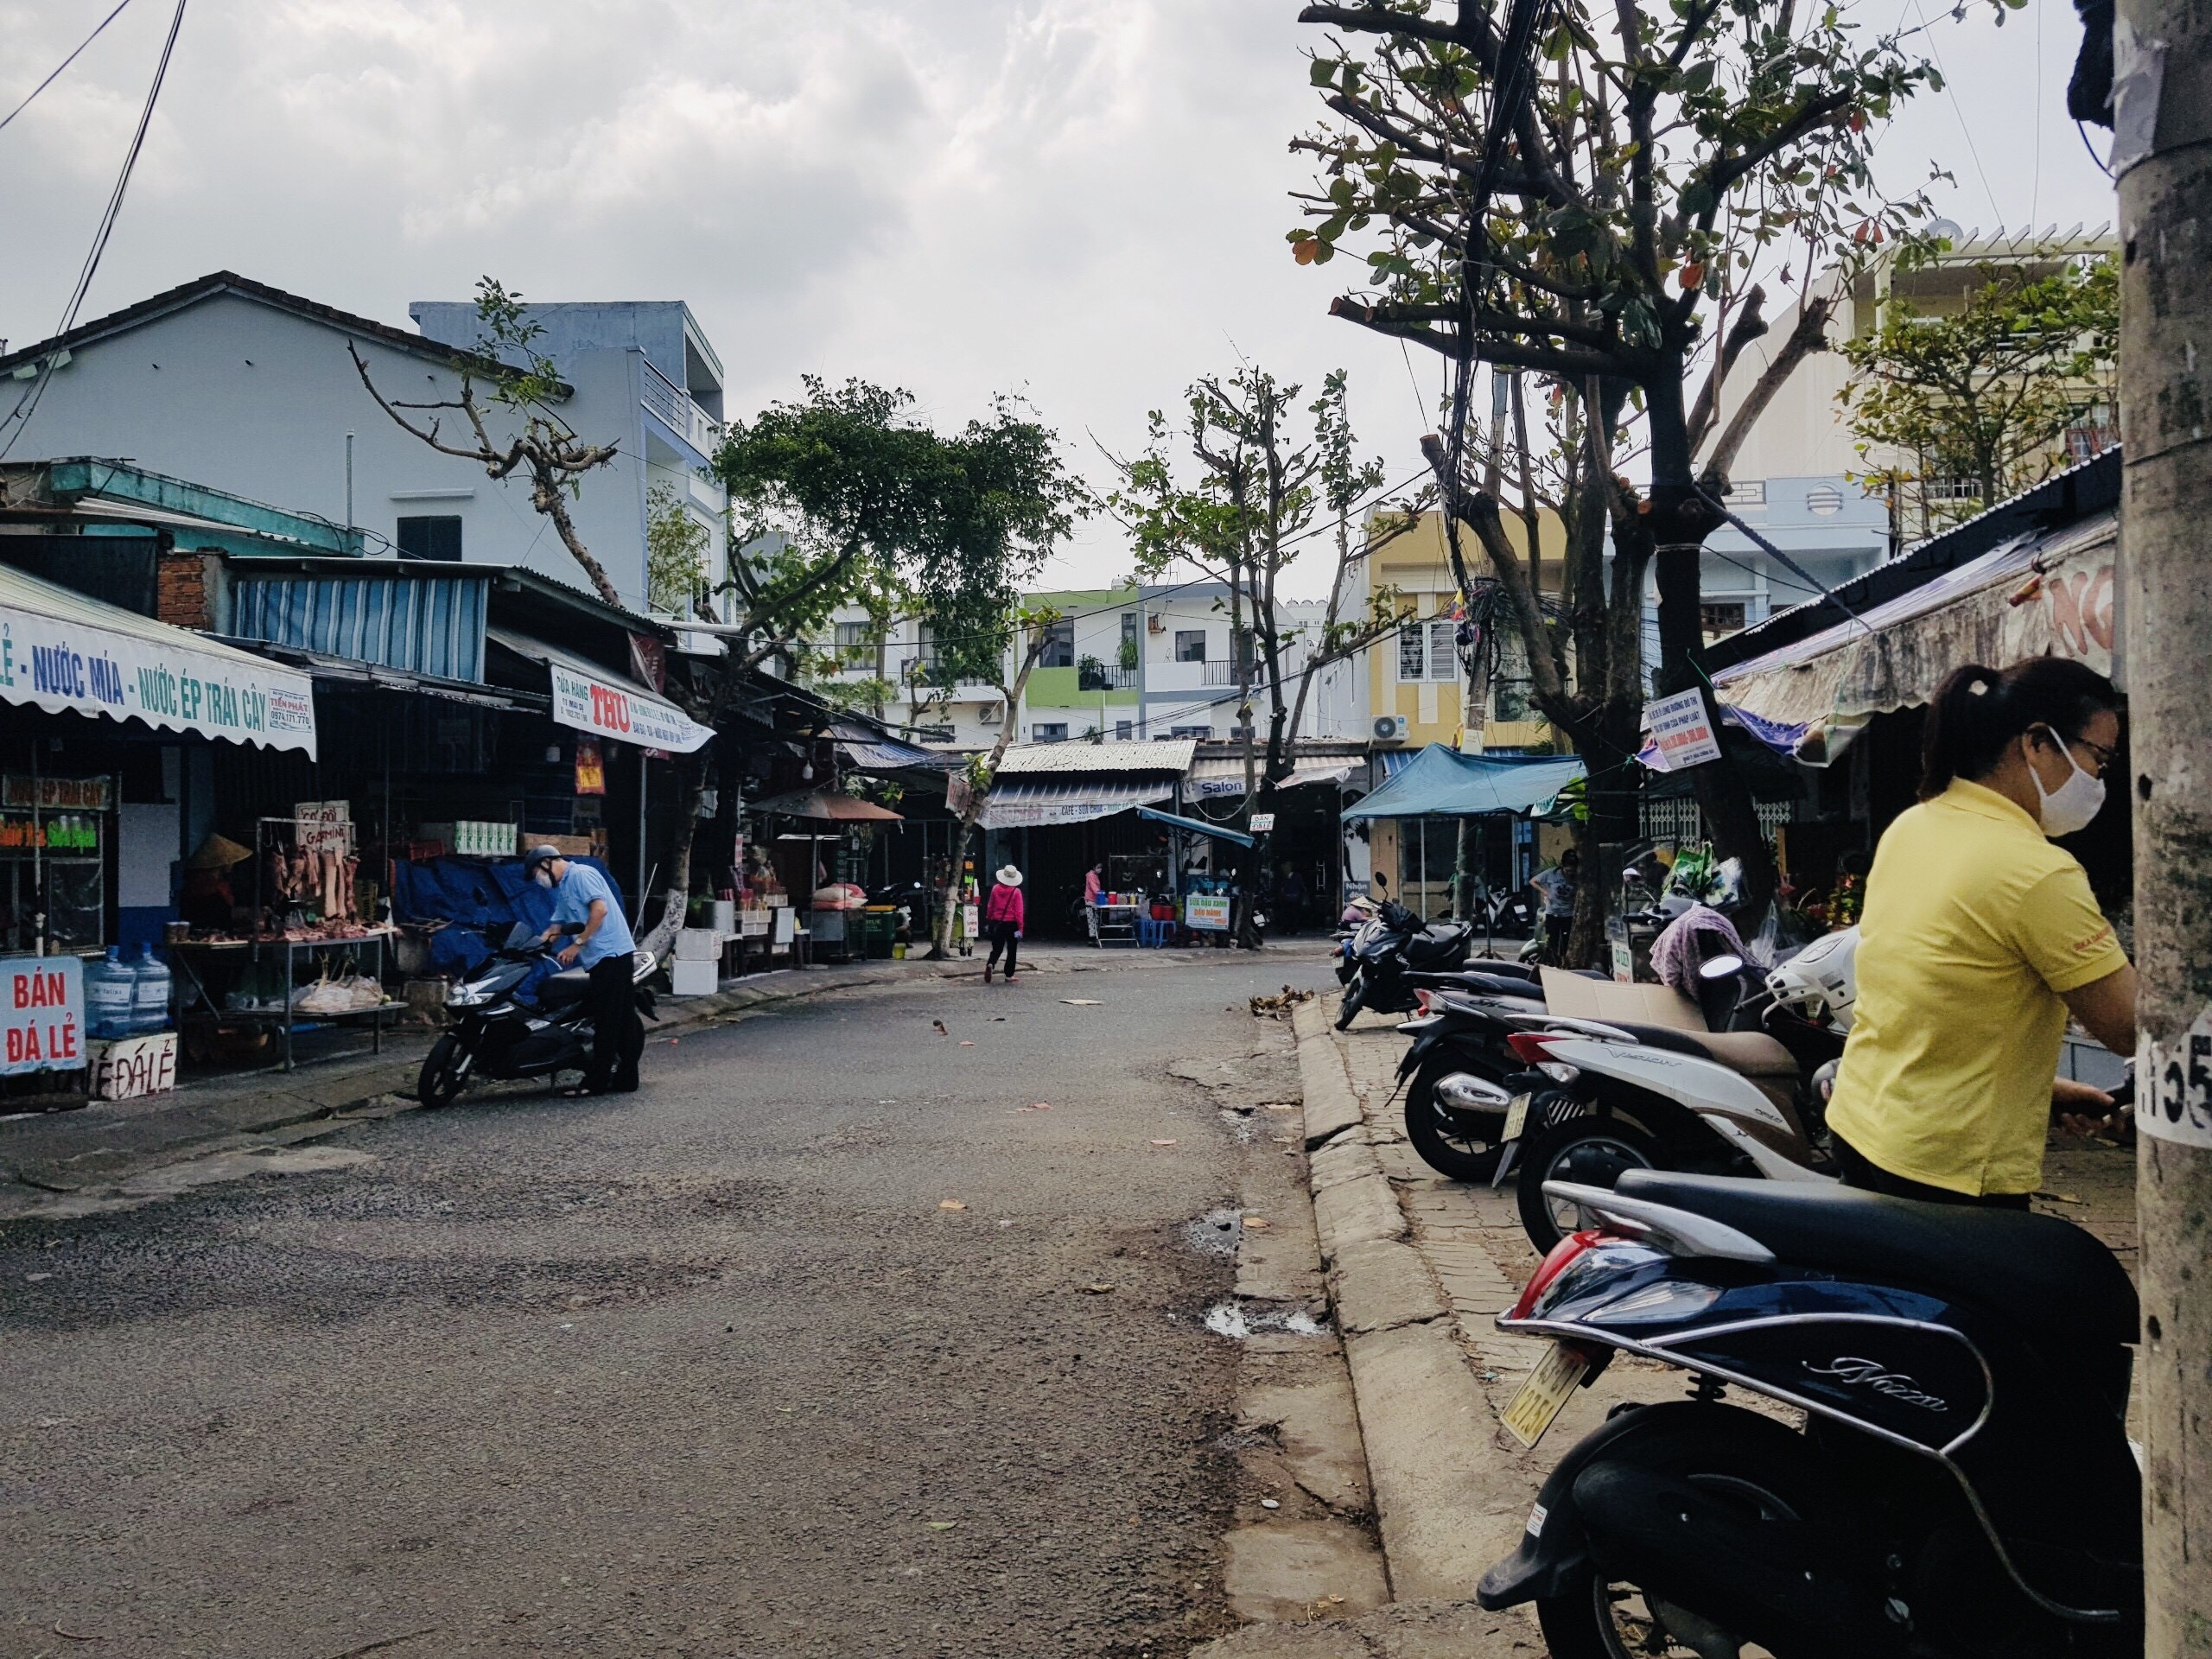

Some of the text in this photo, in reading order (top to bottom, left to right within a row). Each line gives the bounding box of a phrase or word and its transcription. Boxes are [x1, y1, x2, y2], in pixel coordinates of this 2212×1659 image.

[0, 622, 265, 733] Ẻ NƯỚC MÍA NƯỚC ÉP TRÁI CÂY
[590, 683, 631, 733] THU
[1202, 782, 1242, 794] Salon
[1345, 882, 1367, 891] Nhận
[13, 966, 66, 1009] BÁN
[6, 1012, 77, 1063] ĐÁ LẺ
[146, 1039, 174, 1093] LẺ
